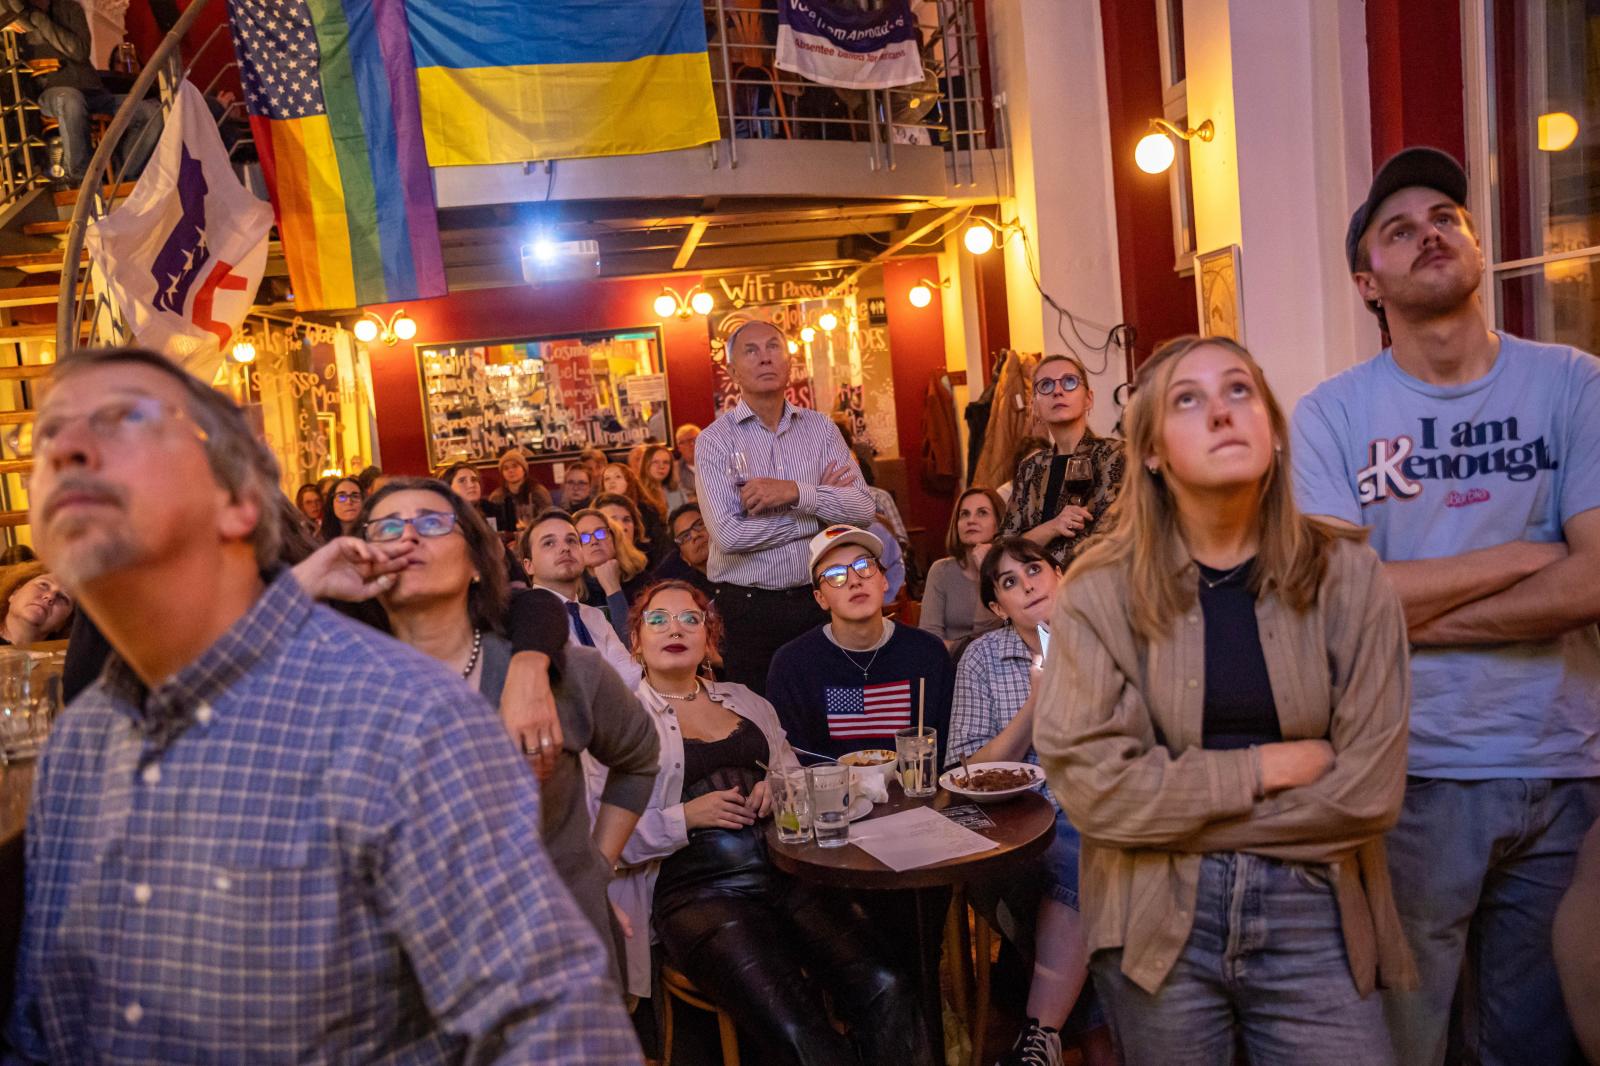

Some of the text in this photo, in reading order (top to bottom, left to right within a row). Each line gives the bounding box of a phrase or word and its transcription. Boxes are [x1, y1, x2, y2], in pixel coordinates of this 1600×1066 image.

[719, 274, 775, 302] WiFi
[1417, 416, 1521, 450] I am
